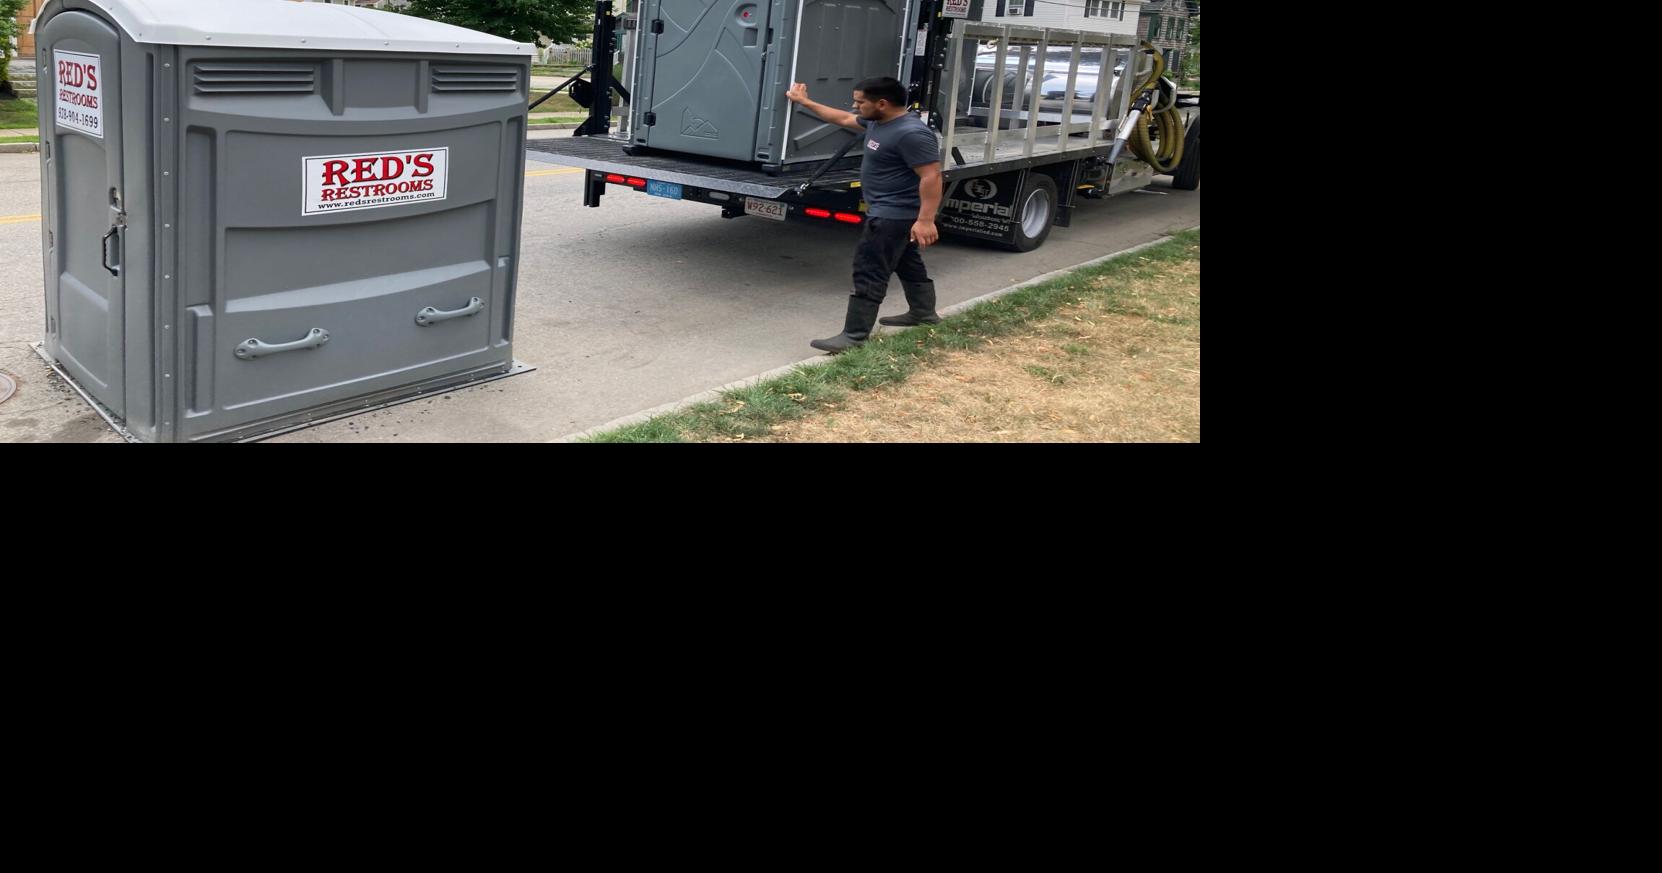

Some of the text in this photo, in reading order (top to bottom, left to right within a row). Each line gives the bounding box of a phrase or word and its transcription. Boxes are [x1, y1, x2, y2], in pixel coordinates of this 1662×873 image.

[58, 60, 98, 91] RED'S
[58, 88, 98, 109] RESTROOMS
[321, 153, 435, 187] RED'S
[317, 191, 435, 209] www.redsrestrooms.com
[321, 179, 434, 202] RESTROOMS
[943, 198, 1013, 219] mperial
